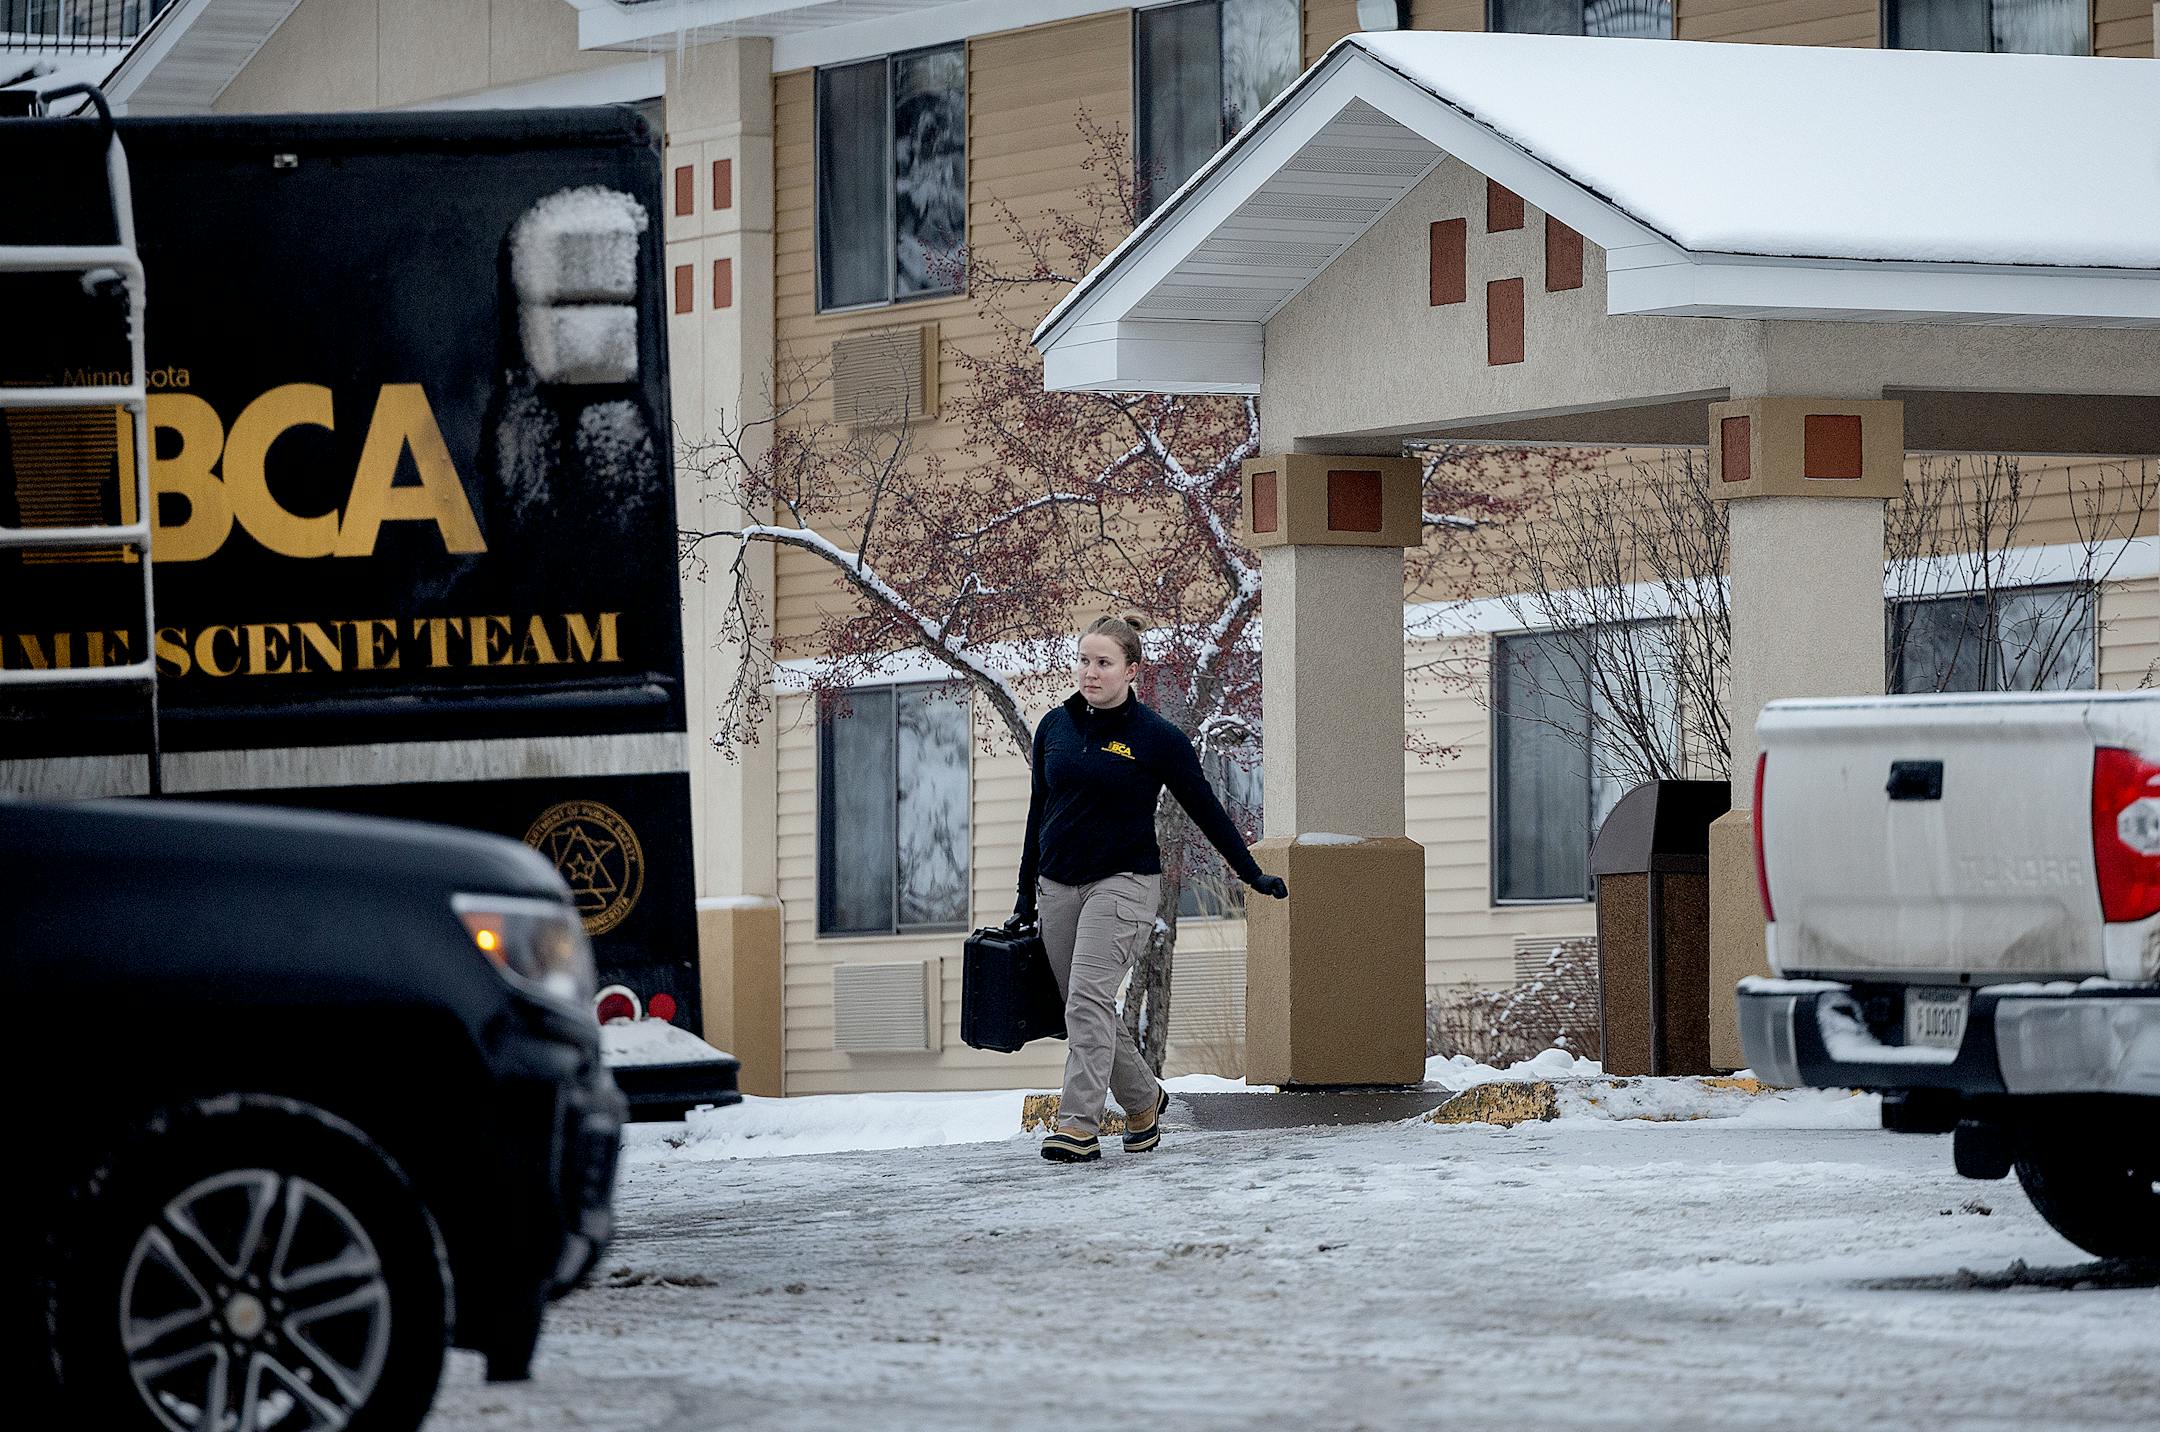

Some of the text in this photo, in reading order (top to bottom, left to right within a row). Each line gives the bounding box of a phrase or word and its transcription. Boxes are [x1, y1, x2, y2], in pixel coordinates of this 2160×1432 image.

[114, 382, 488, 564] BCA
[0, 612, 624, 678] ME SCENE TEAM
[1111, 743, 1131, 756] BCA
